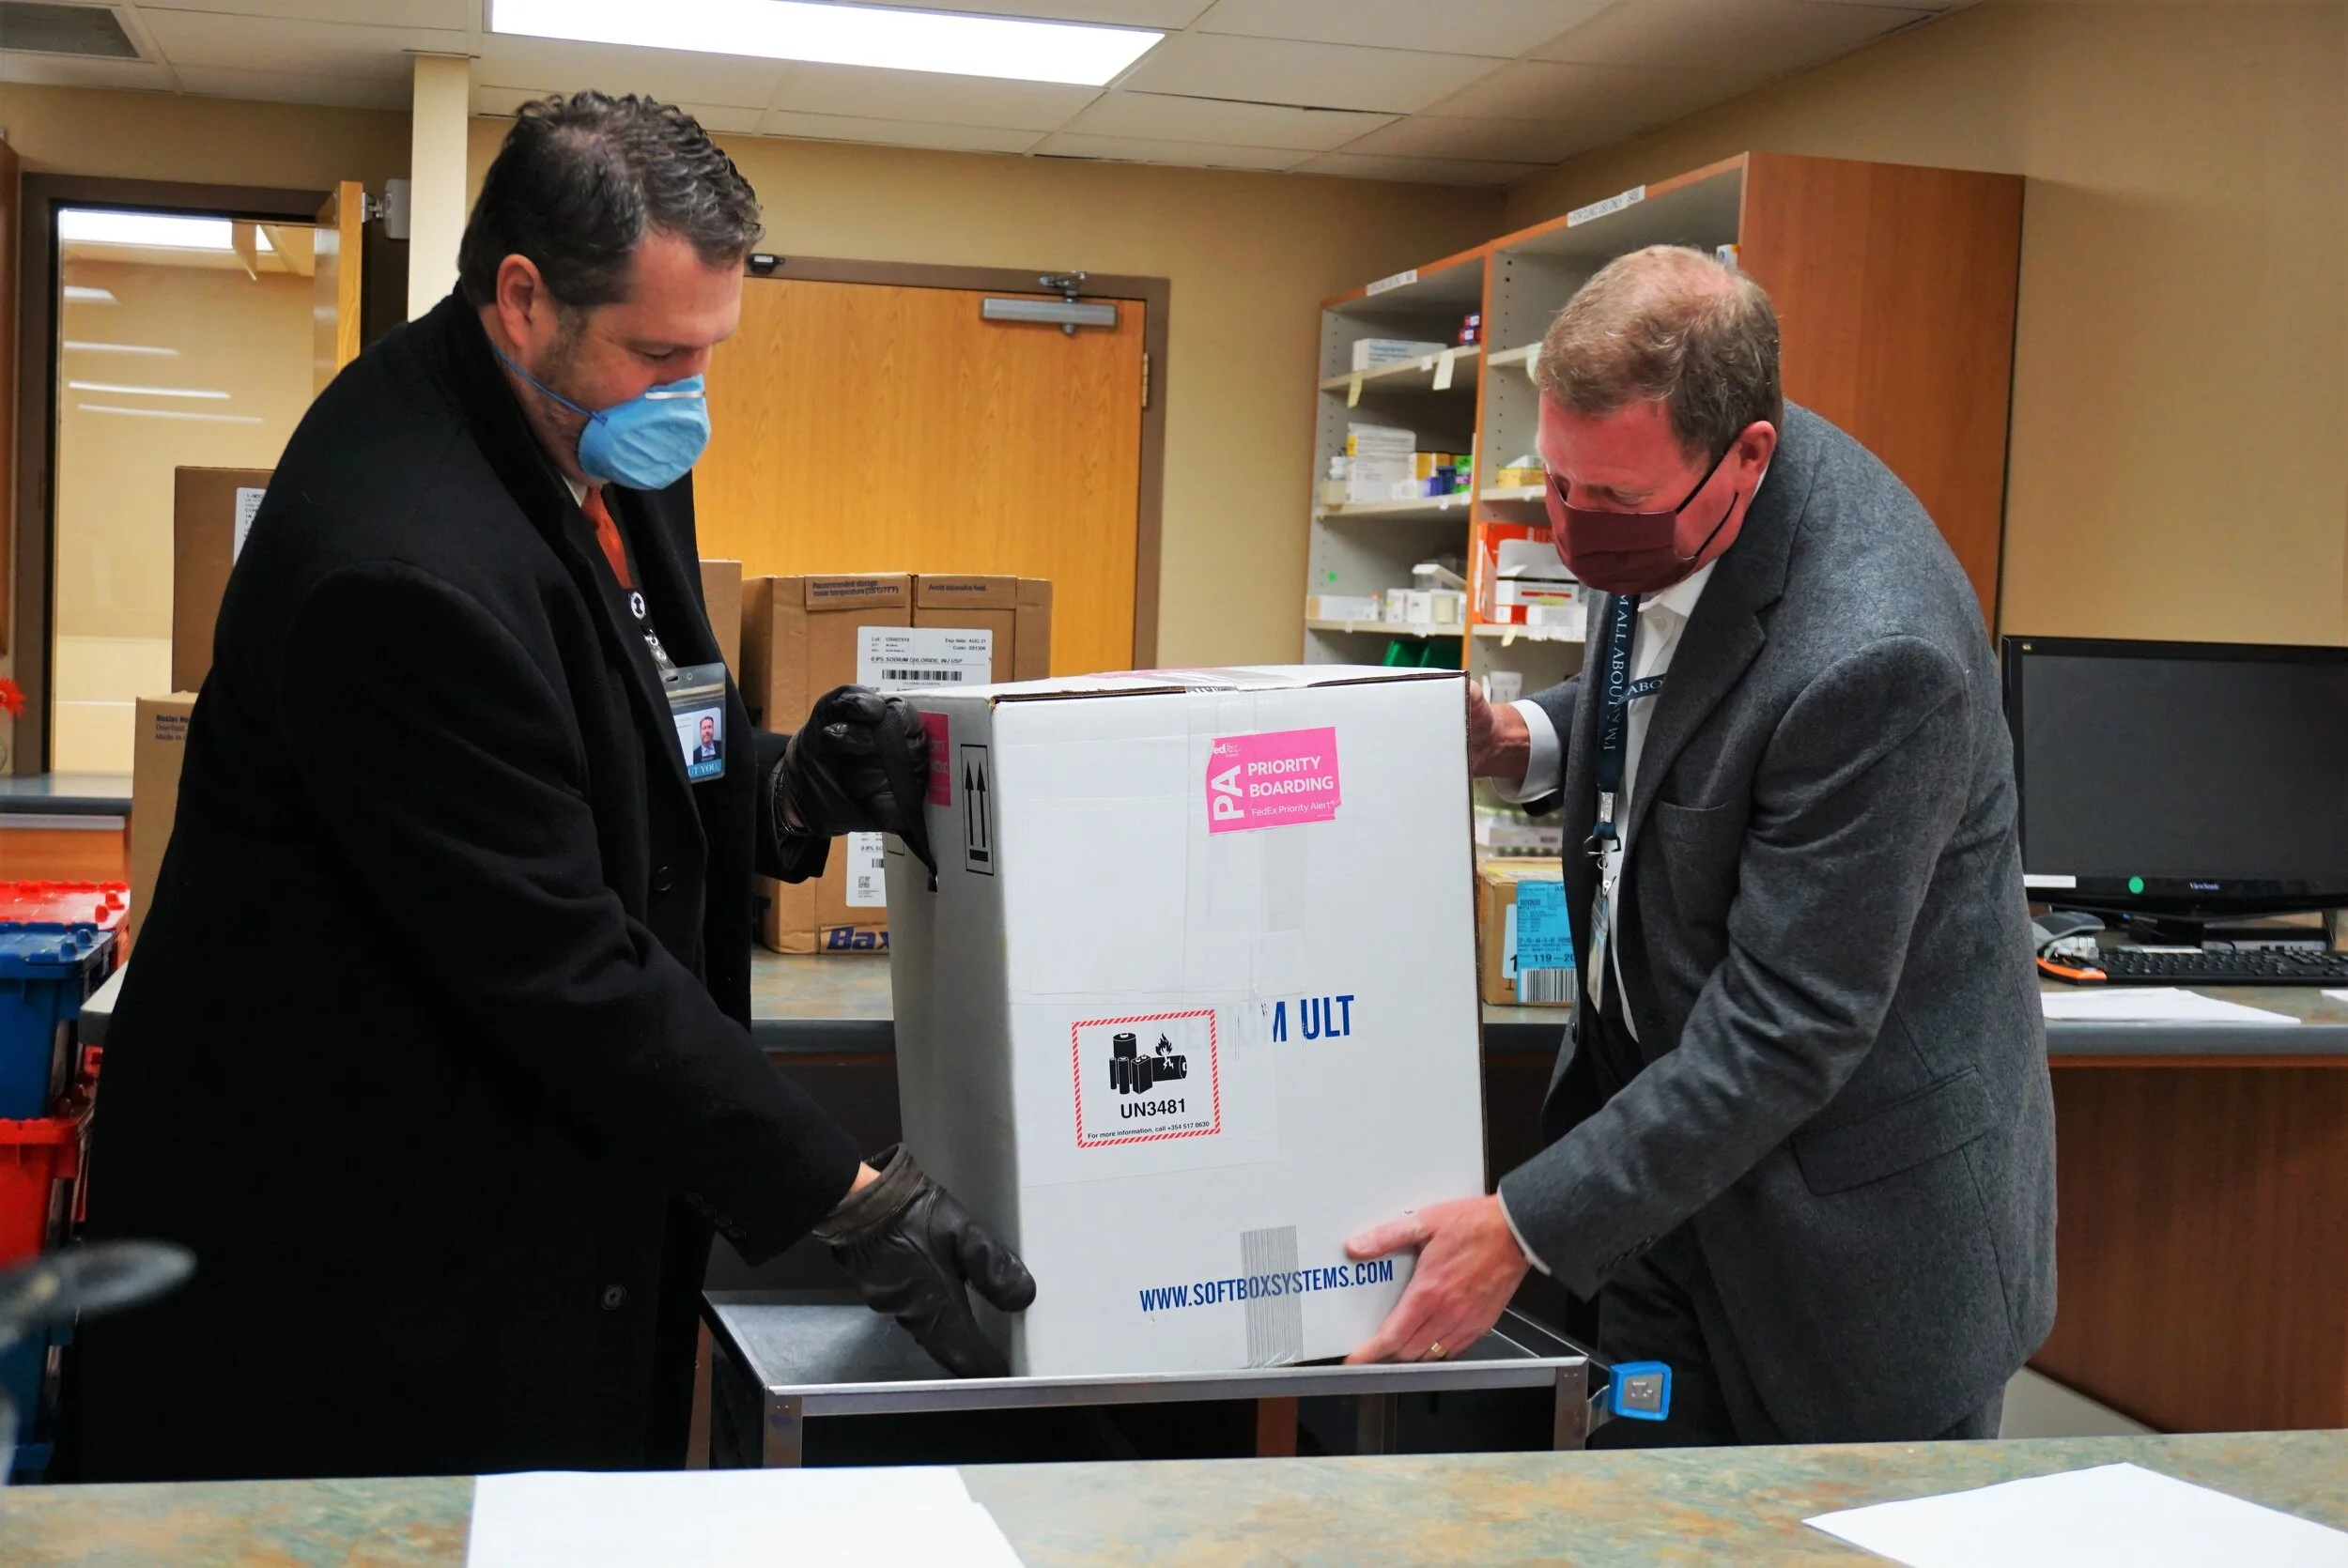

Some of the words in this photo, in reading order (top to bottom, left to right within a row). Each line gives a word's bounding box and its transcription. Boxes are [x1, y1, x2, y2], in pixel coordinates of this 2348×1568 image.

[1614, 609, 1628, 643] ALL
[1247, 756, 1321, 776] PRIORITY
[1211, 764, 1244, 822] PA
[1249, 776, 1334, 798] BOARDING
[1251, 807, 1277, 817] FedEx
[1278, 803, 1309, 814] Priority
[1300, 994, 1354, 1040] ULT
[1120, 1098, 1185, 1119] UN3481
[1117, 1128, 1153, 1136] information,
[1139, 1259, 1394, 1313] WWW.SOFTBOXSYSTEMS.COM
